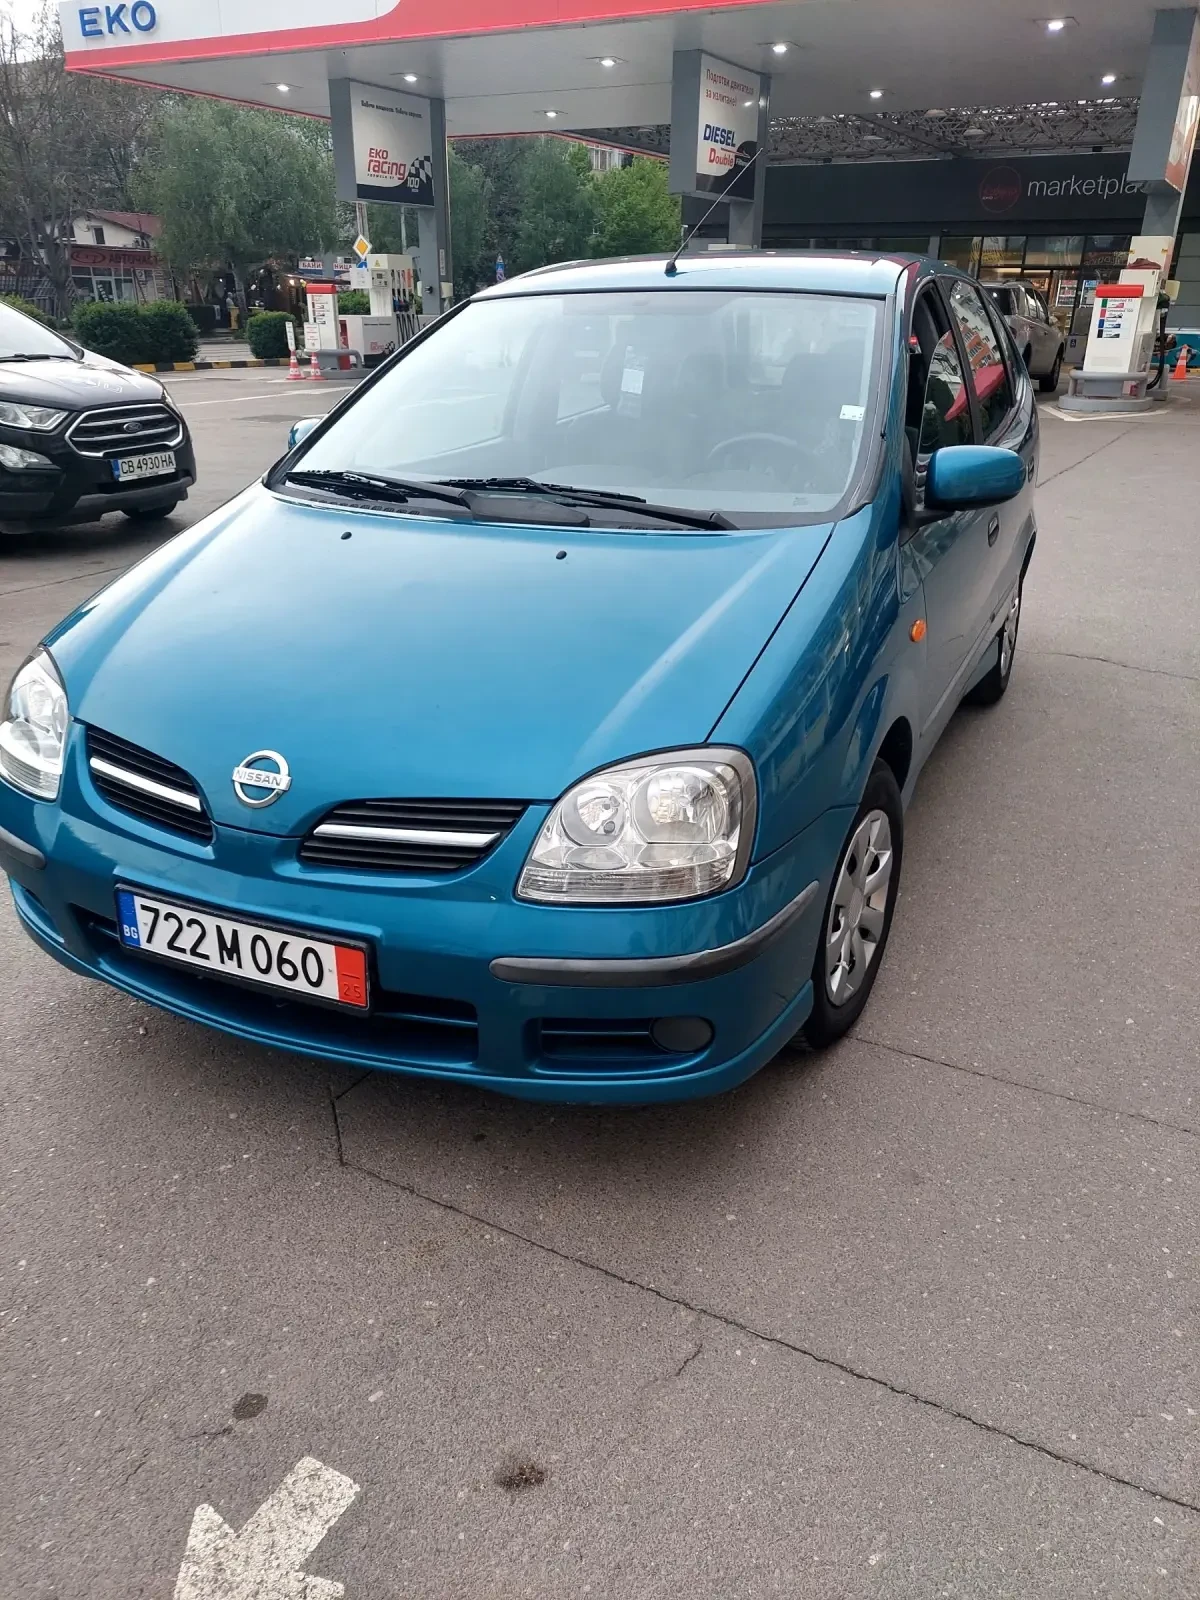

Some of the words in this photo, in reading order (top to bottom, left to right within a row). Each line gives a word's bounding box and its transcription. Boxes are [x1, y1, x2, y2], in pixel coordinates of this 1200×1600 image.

[79, 0, 156, 37] EKO
[703, 124, 736, 148] DIESEL
[369, 147, 389, 160] EKO
[708, 147, 734, 167] Double
[367, 159, 407, 181] racing
[407, 176, 420, 189] 100
[1027, 172, 1145, 200] marketpla
[108, 253, 160, 266] АВТОЧАСТ
[121, 460, 135, 475] CB
[136, 456, 160, 472] 4930
[160, 453, 174, 468] HA
[234, 769, 282, 787] NISSAN
[123, 924, 139, 940] BG
[140, 903, 210, 961] 722
[215, 924, 243, 970] M
[250, 934, 324, 989] 060
[343, 983, 362, 999] 25
